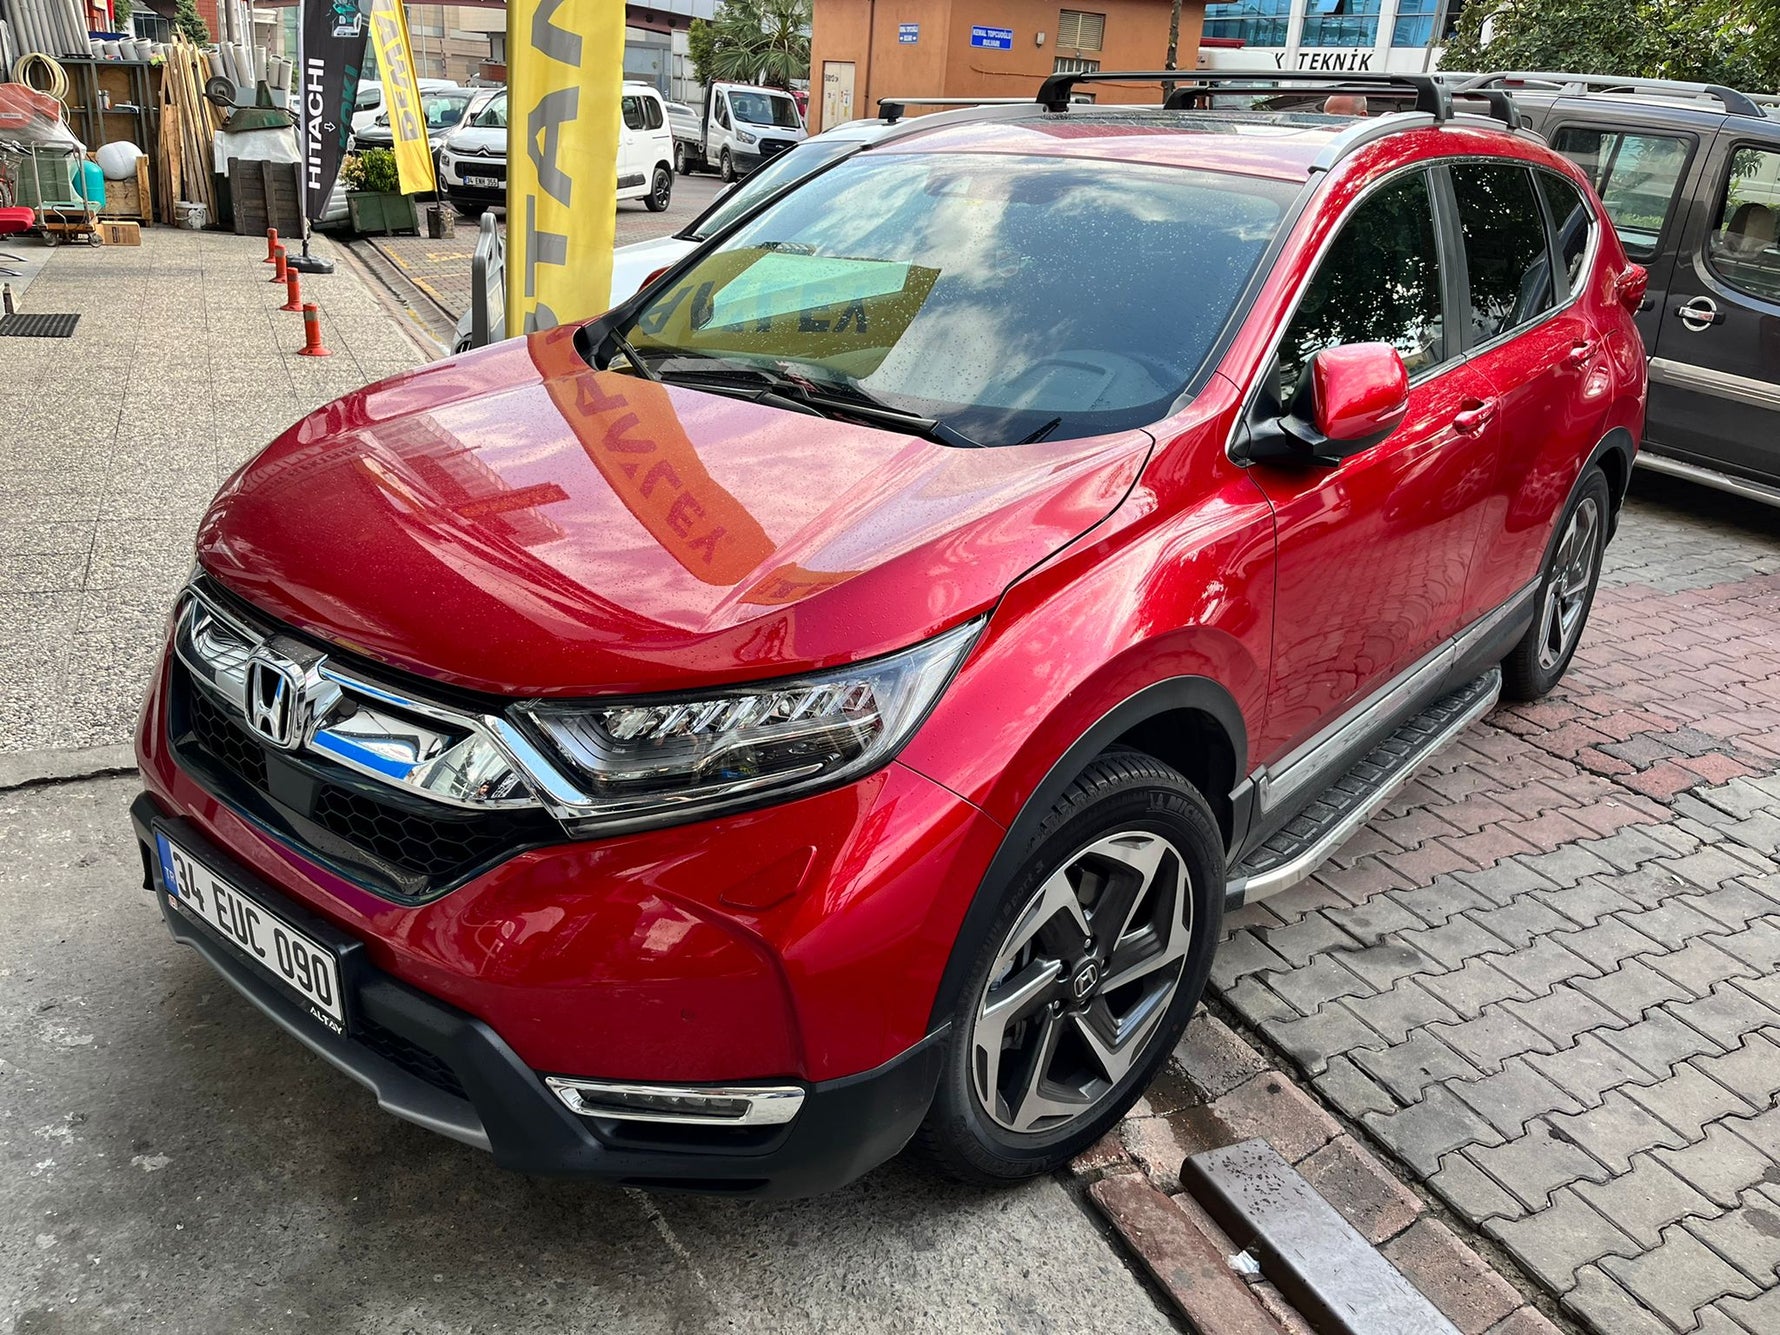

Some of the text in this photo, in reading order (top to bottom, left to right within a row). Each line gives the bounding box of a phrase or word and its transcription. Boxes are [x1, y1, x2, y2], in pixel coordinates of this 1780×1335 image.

[1299, 49, 1375, 71] TEKNİK
[308, 58, 325, 190] HITACHI
[173, 851, 205, 912] 34
[211, 880, 266, 959] EUC
[273, 927, 333, 1007] 090
[310, 1006, 343, 1035] ALTAY
